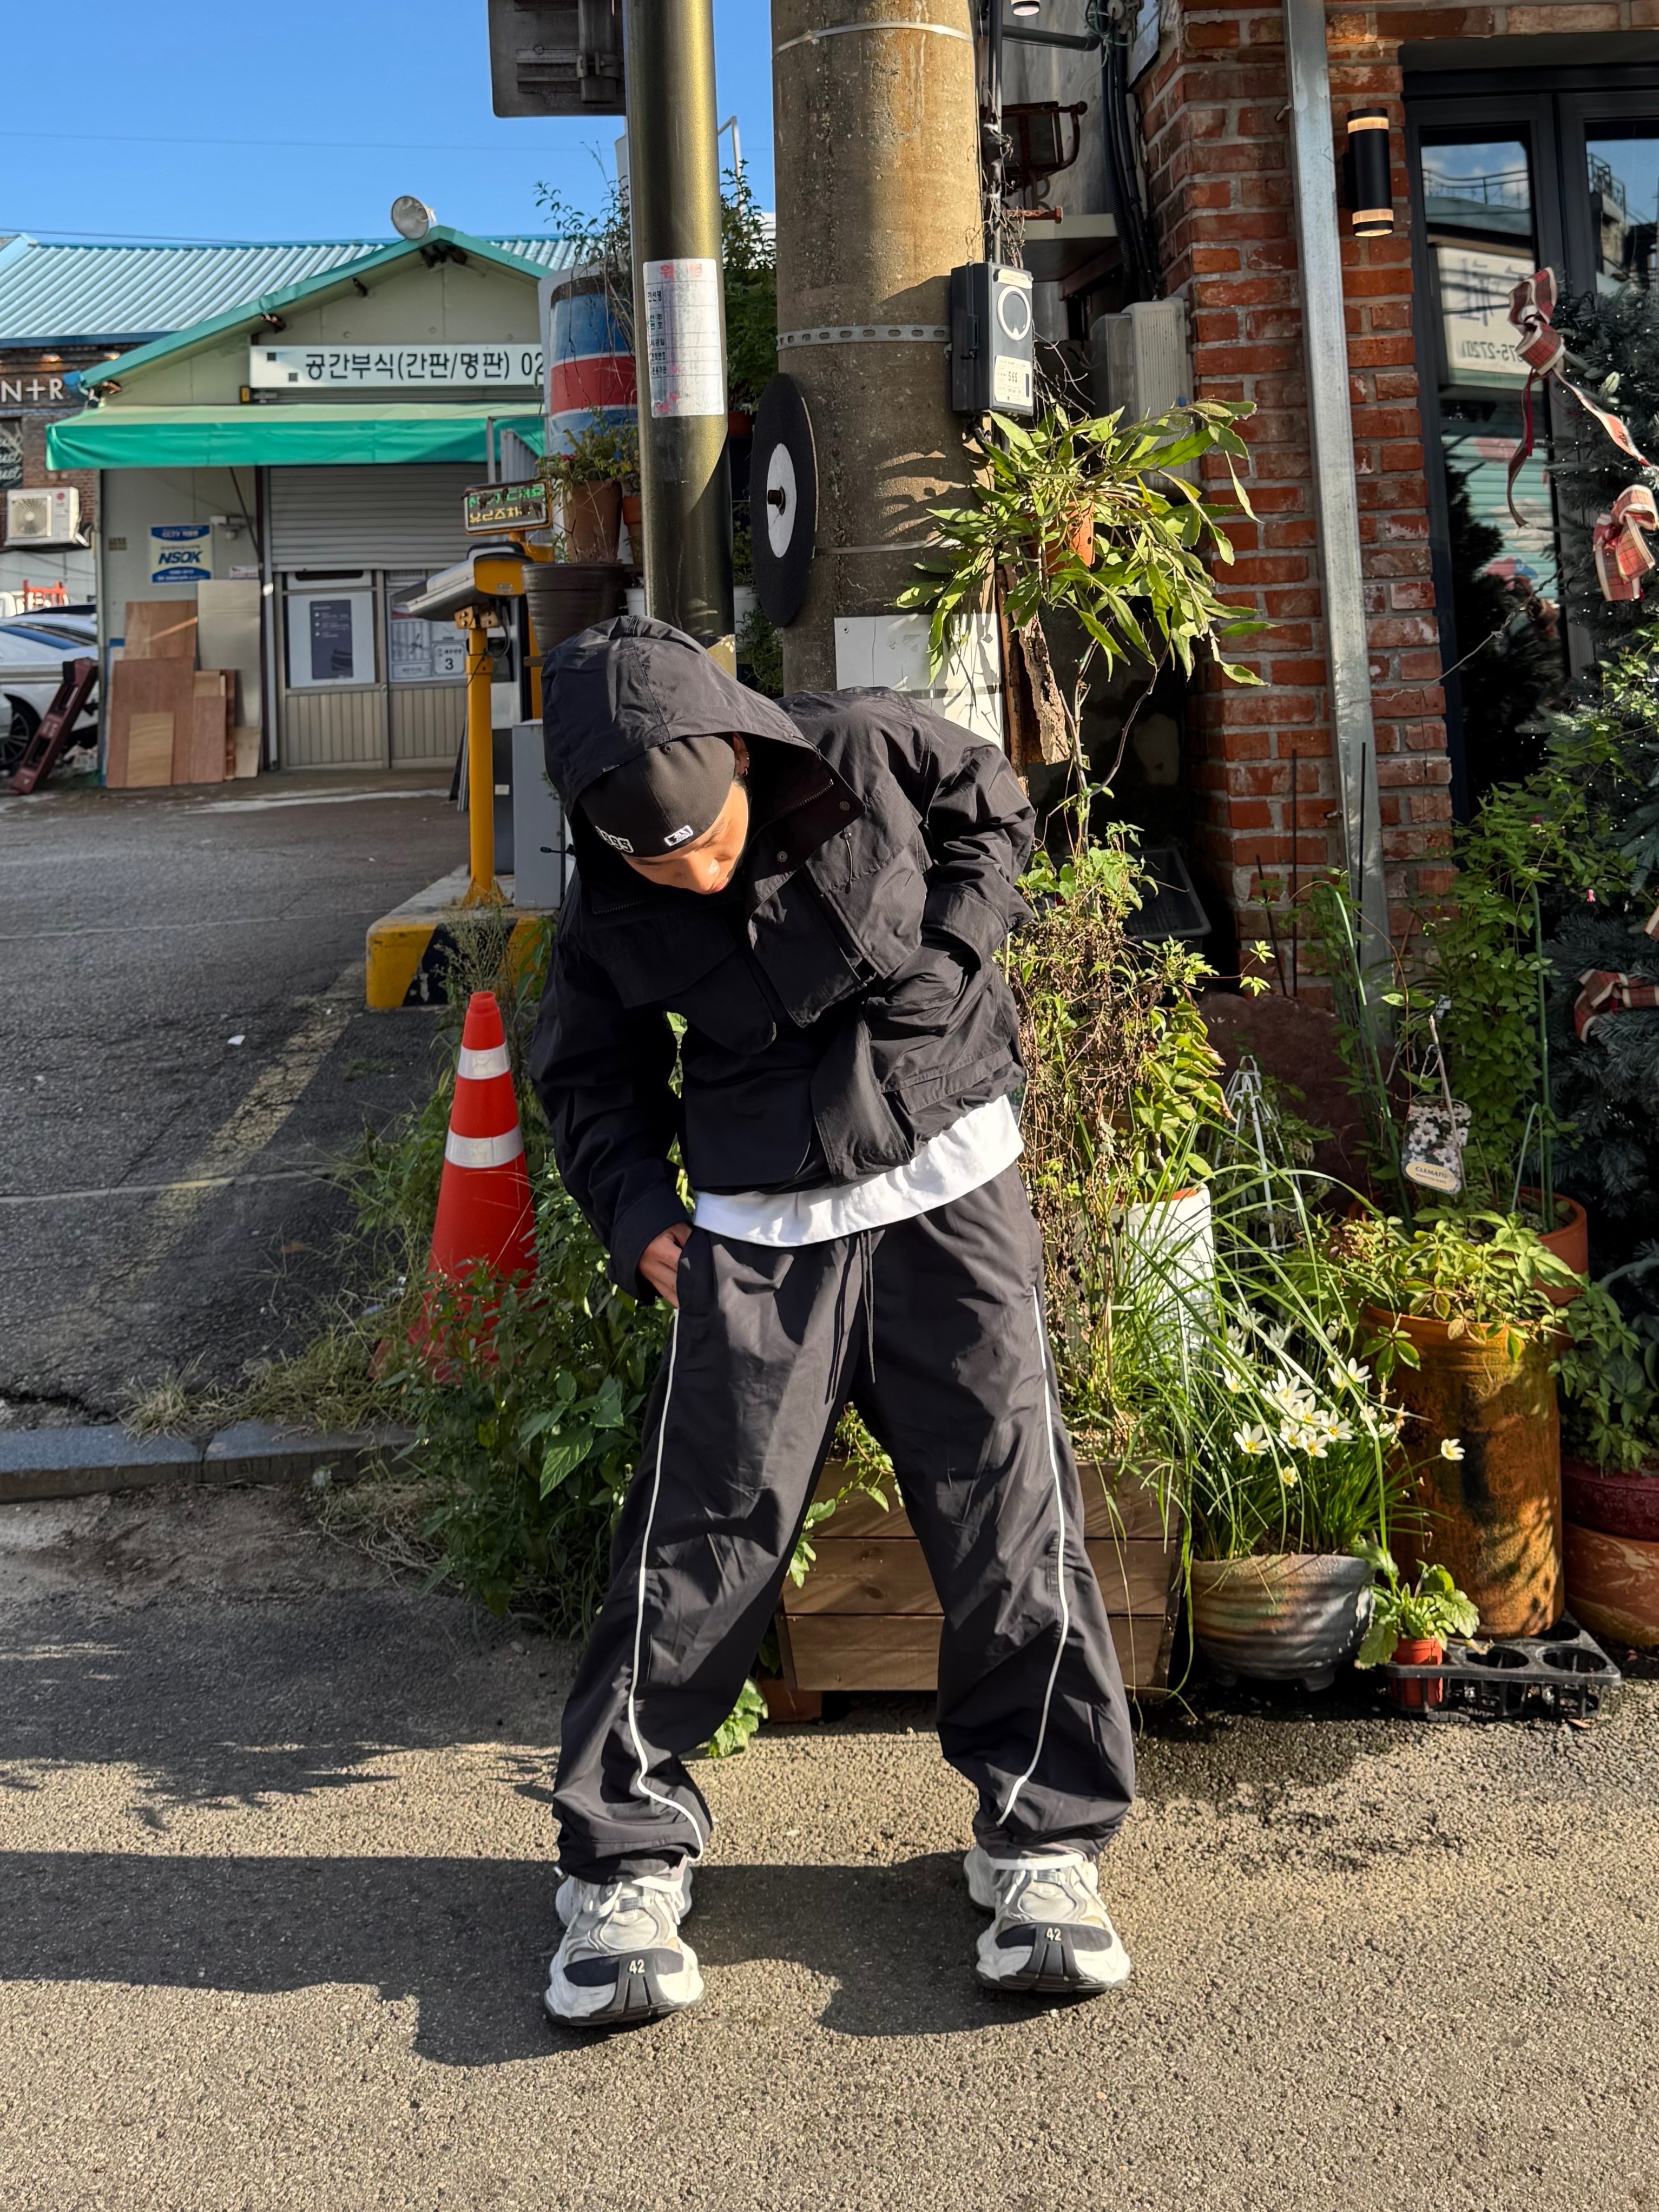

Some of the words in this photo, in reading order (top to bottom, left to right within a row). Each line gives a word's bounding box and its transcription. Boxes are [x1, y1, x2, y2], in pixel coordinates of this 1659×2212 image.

[158, 551, 202, 565] NSOK
[445, 658, 454, 670] 3
[1046, 1927, 1062, 1941] 42
[629, 1959, 645, 1974] 42
